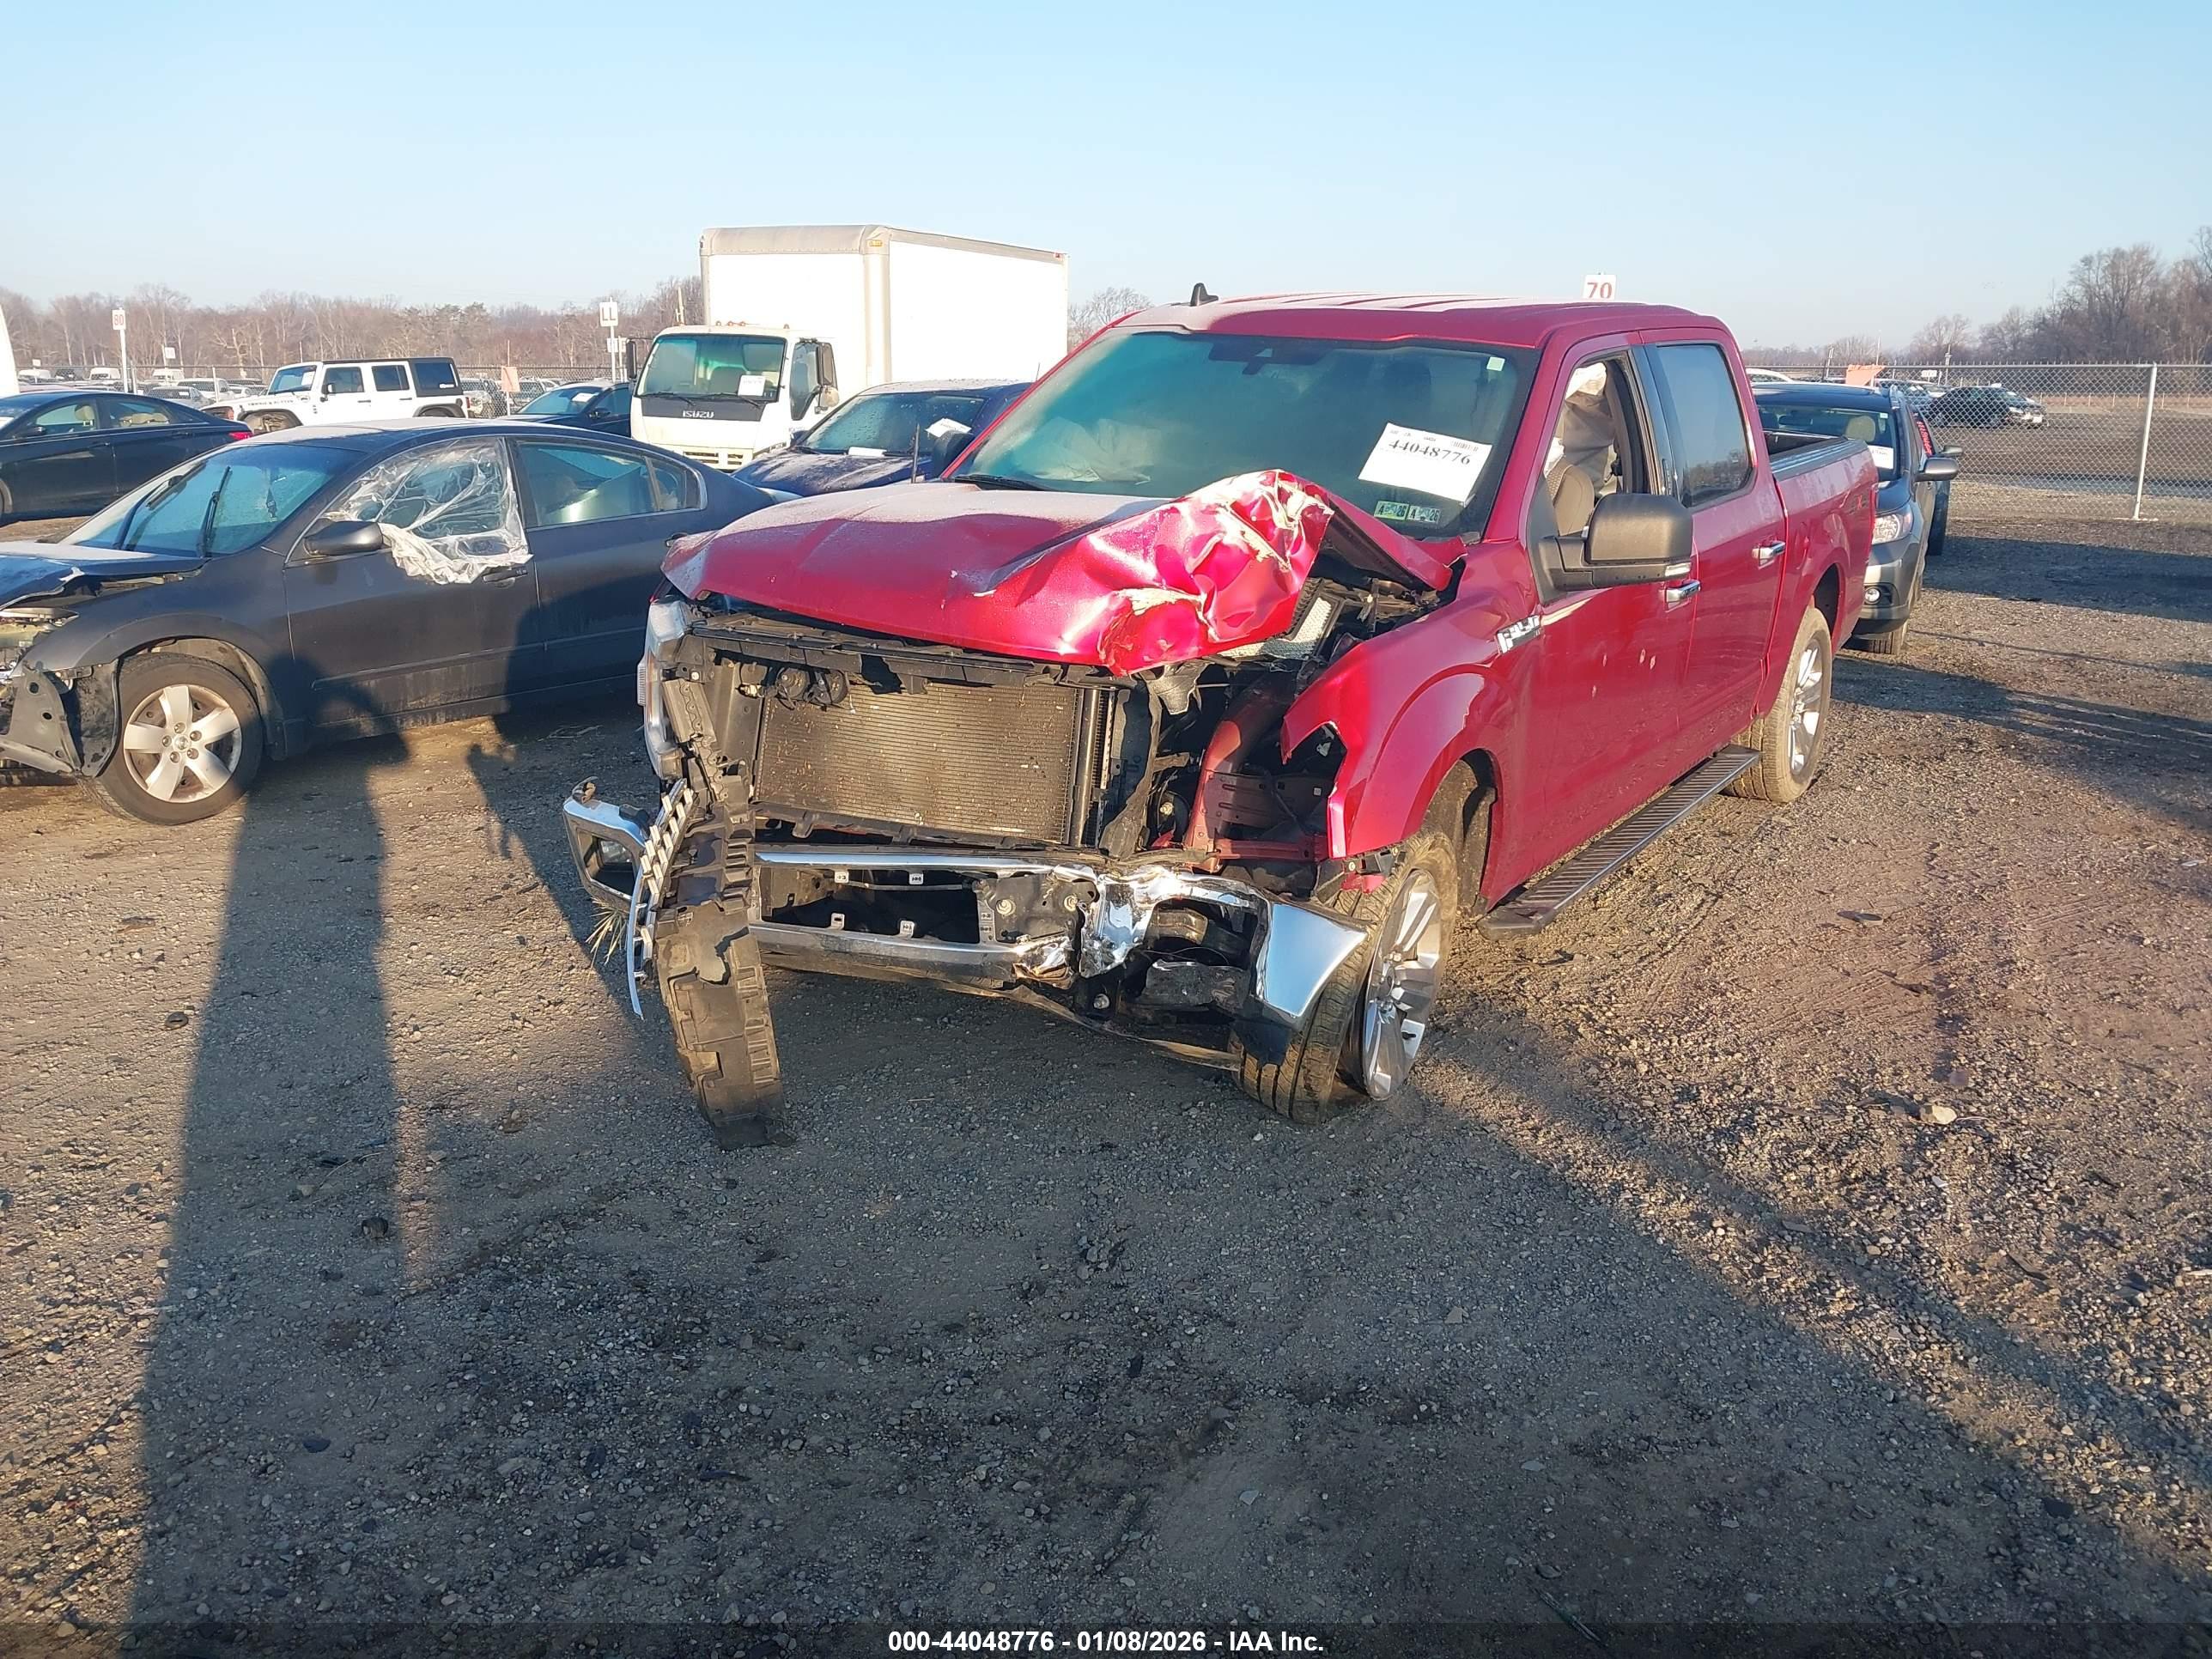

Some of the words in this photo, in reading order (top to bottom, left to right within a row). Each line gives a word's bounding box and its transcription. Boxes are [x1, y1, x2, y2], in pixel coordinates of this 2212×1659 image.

[1587, 282, 1613, 299] 70
[113, 314, 125, 325] 80
[601, 307, 616, 321] LL
[682, 410, 714, 418] ISUZU
[1388, 439, 1471, 465] 44048776
